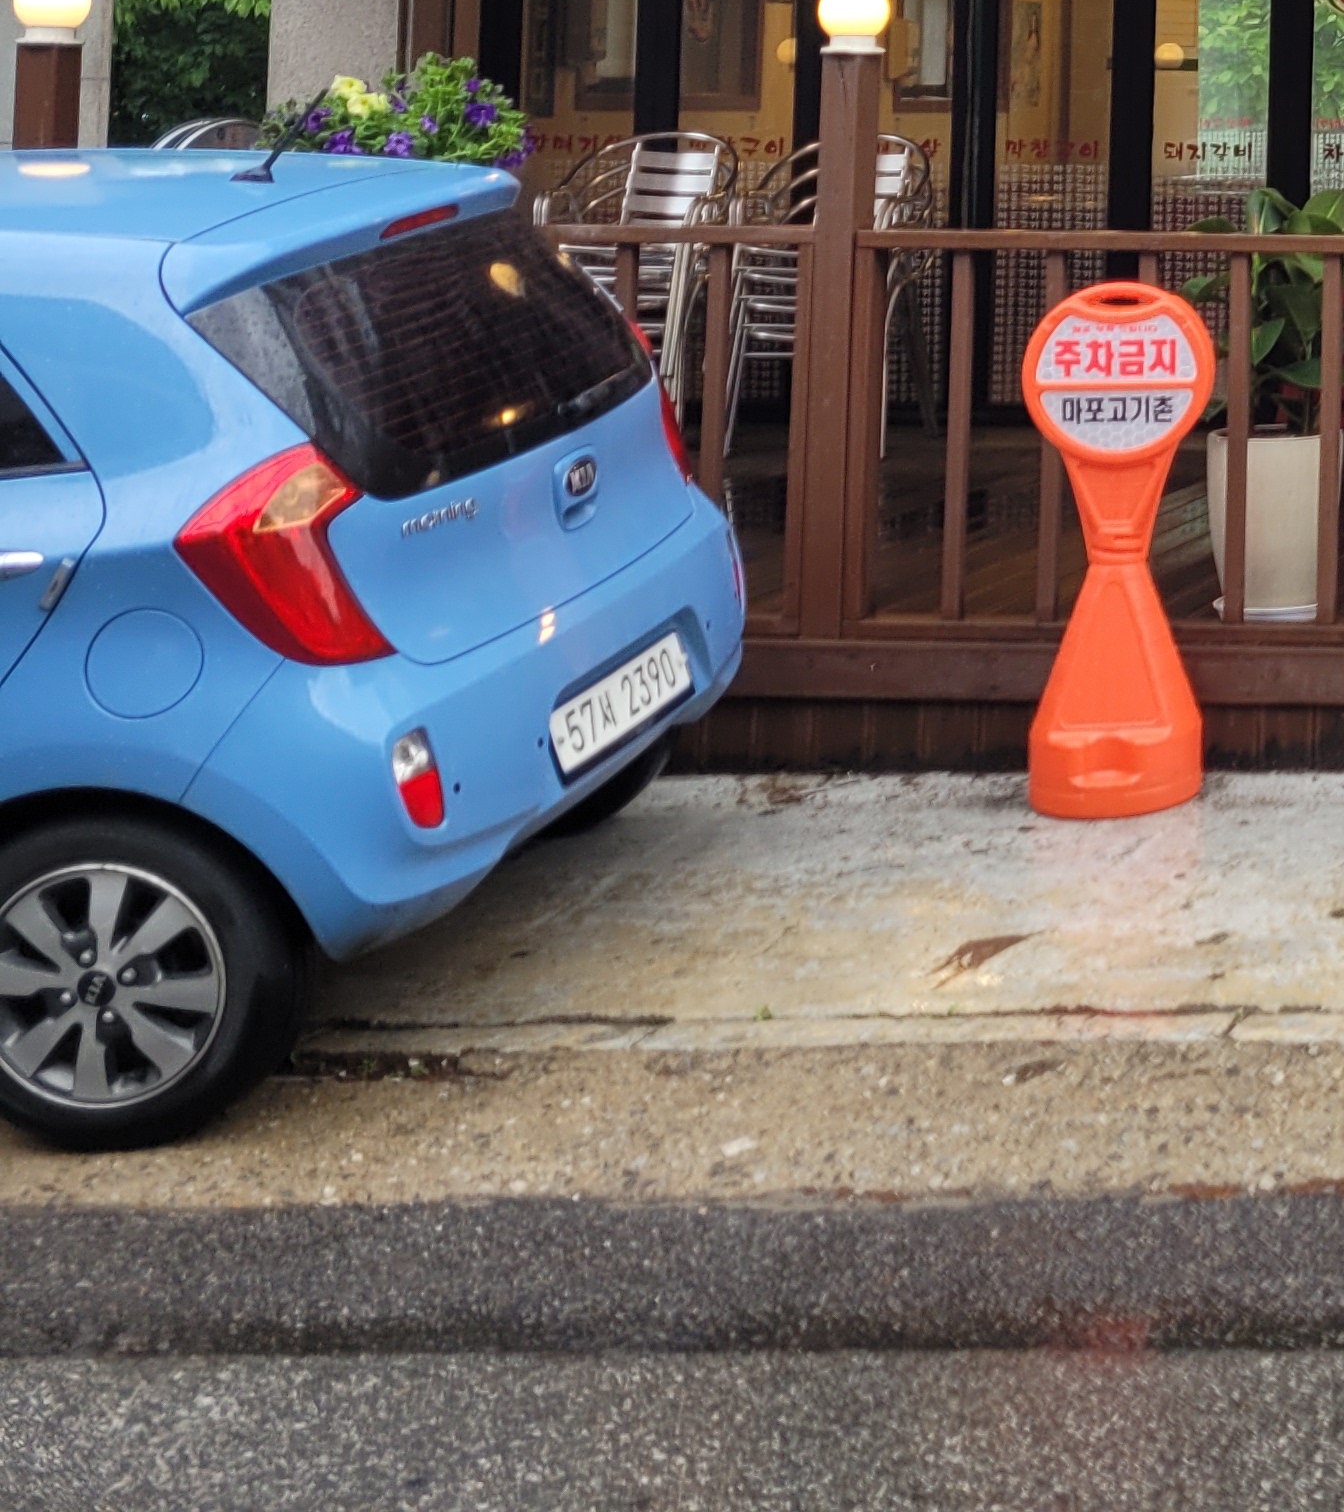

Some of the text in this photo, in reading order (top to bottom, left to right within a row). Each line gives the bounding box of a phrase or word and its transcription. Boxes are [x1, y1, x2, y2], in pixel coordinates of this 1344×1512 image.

[1163, 141, 1253, 162] 돼지갈비
[1054, 339, 1177, 378] 주차금지
[1062, 395, 1174, 424] 마포고기촌
[402, 497, 479, 536] morning
[620, 648, 676, 716] 2390
